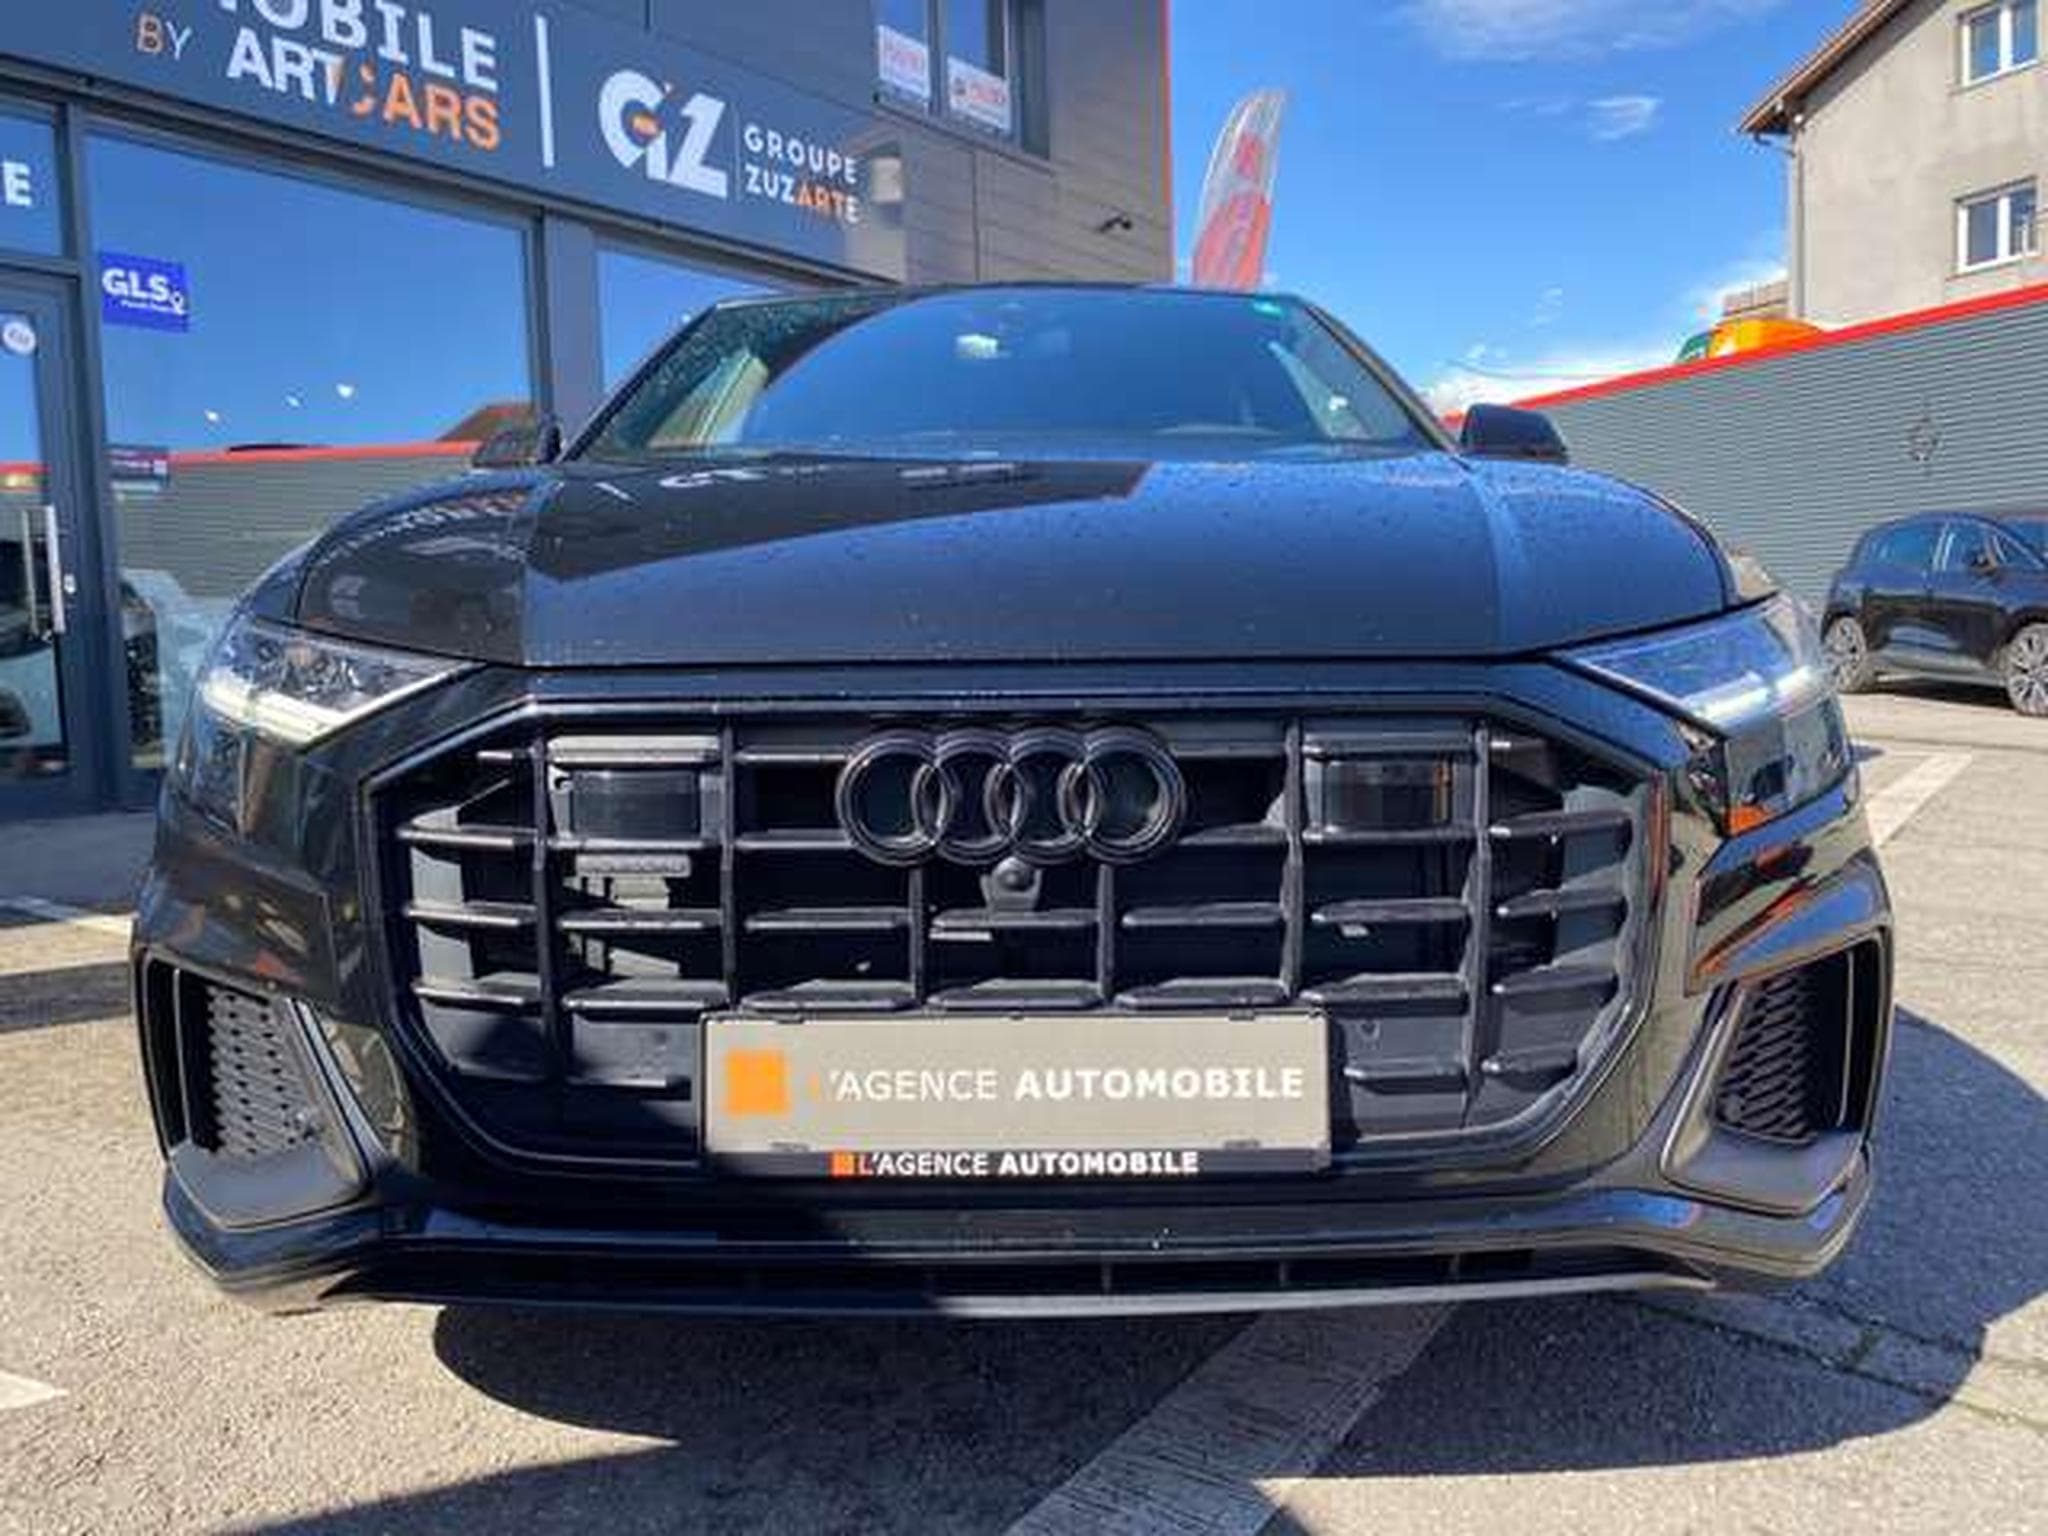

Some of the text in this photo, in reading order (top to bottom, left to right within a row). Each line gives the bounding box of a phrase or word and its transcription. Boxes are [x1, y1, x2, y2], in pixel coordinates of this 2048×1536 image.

[137, 12, 193, 60] BY
[220, 0, 498, 91] OBILE
[743, 123, 858, 184] GROUPE
[744, 162, 861, 225] ZUZARTE
[102, 268, 171, 302] GLS
[808, 1066, 1305, 1102] 'AGENCE AUTOMOBILE
[858, 1150, 1199, 1177] L'AGENCE AUTOMOBILE
